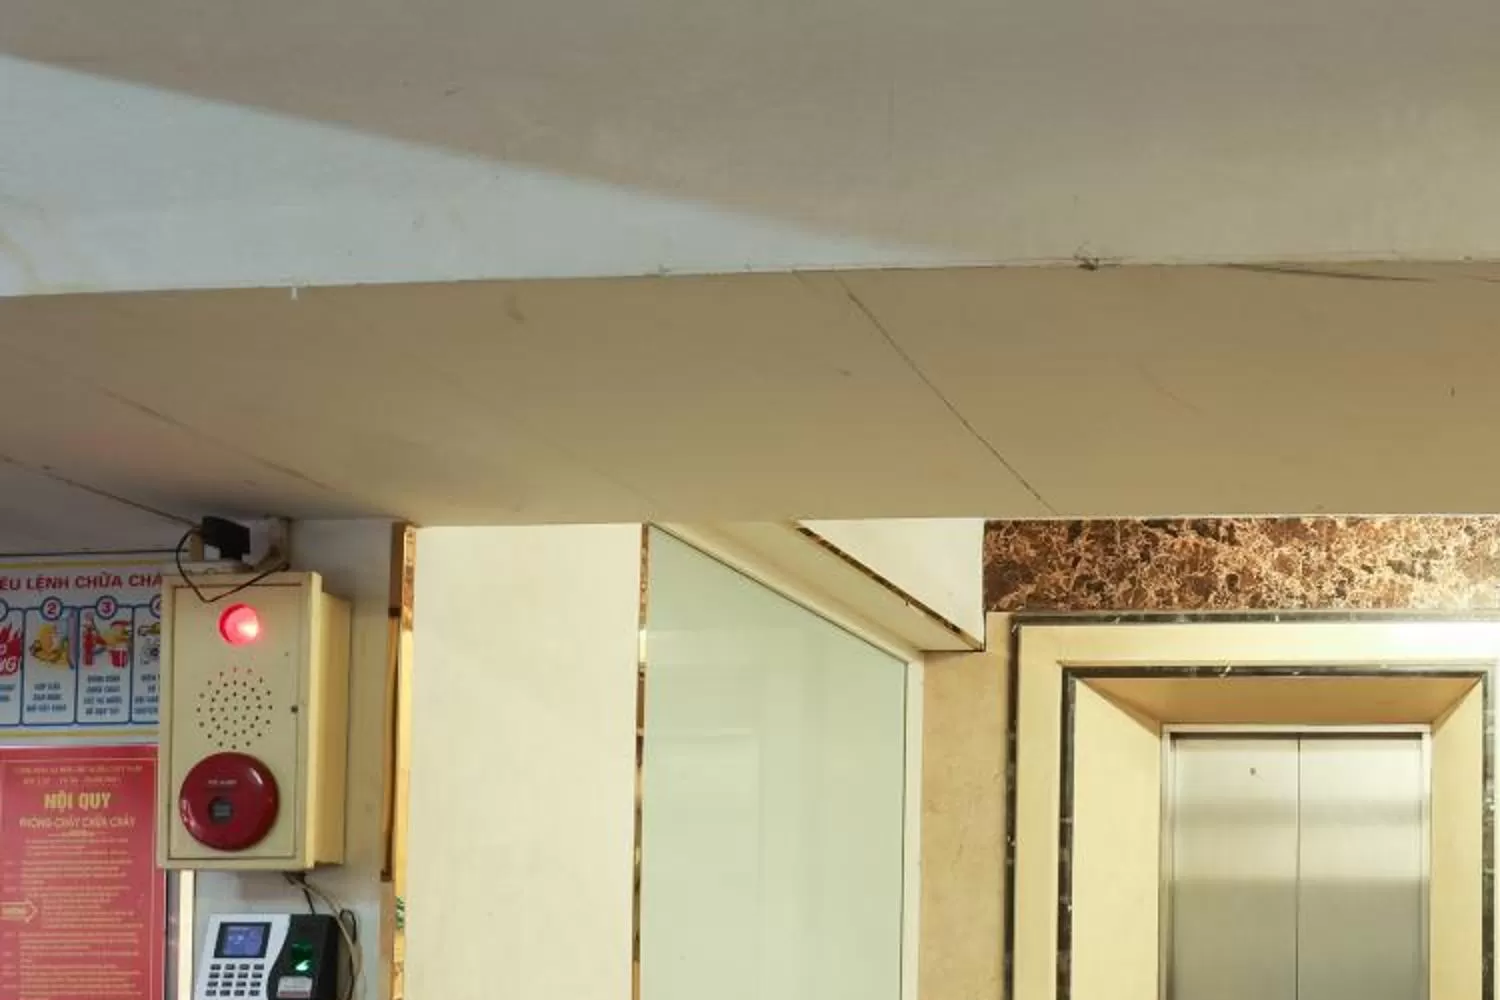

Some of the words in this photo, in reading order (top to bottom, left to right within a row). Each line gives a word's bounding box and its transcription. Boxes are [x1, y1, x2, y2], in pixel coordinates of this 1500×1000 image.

[128, 571, 162, 588] CHÁ
[47, 602, 57, 614] 2
[101, 602, 112, 614] 3
[44, 790, 73, 812] NỘI
[79, 791, 111, 811] QUY
